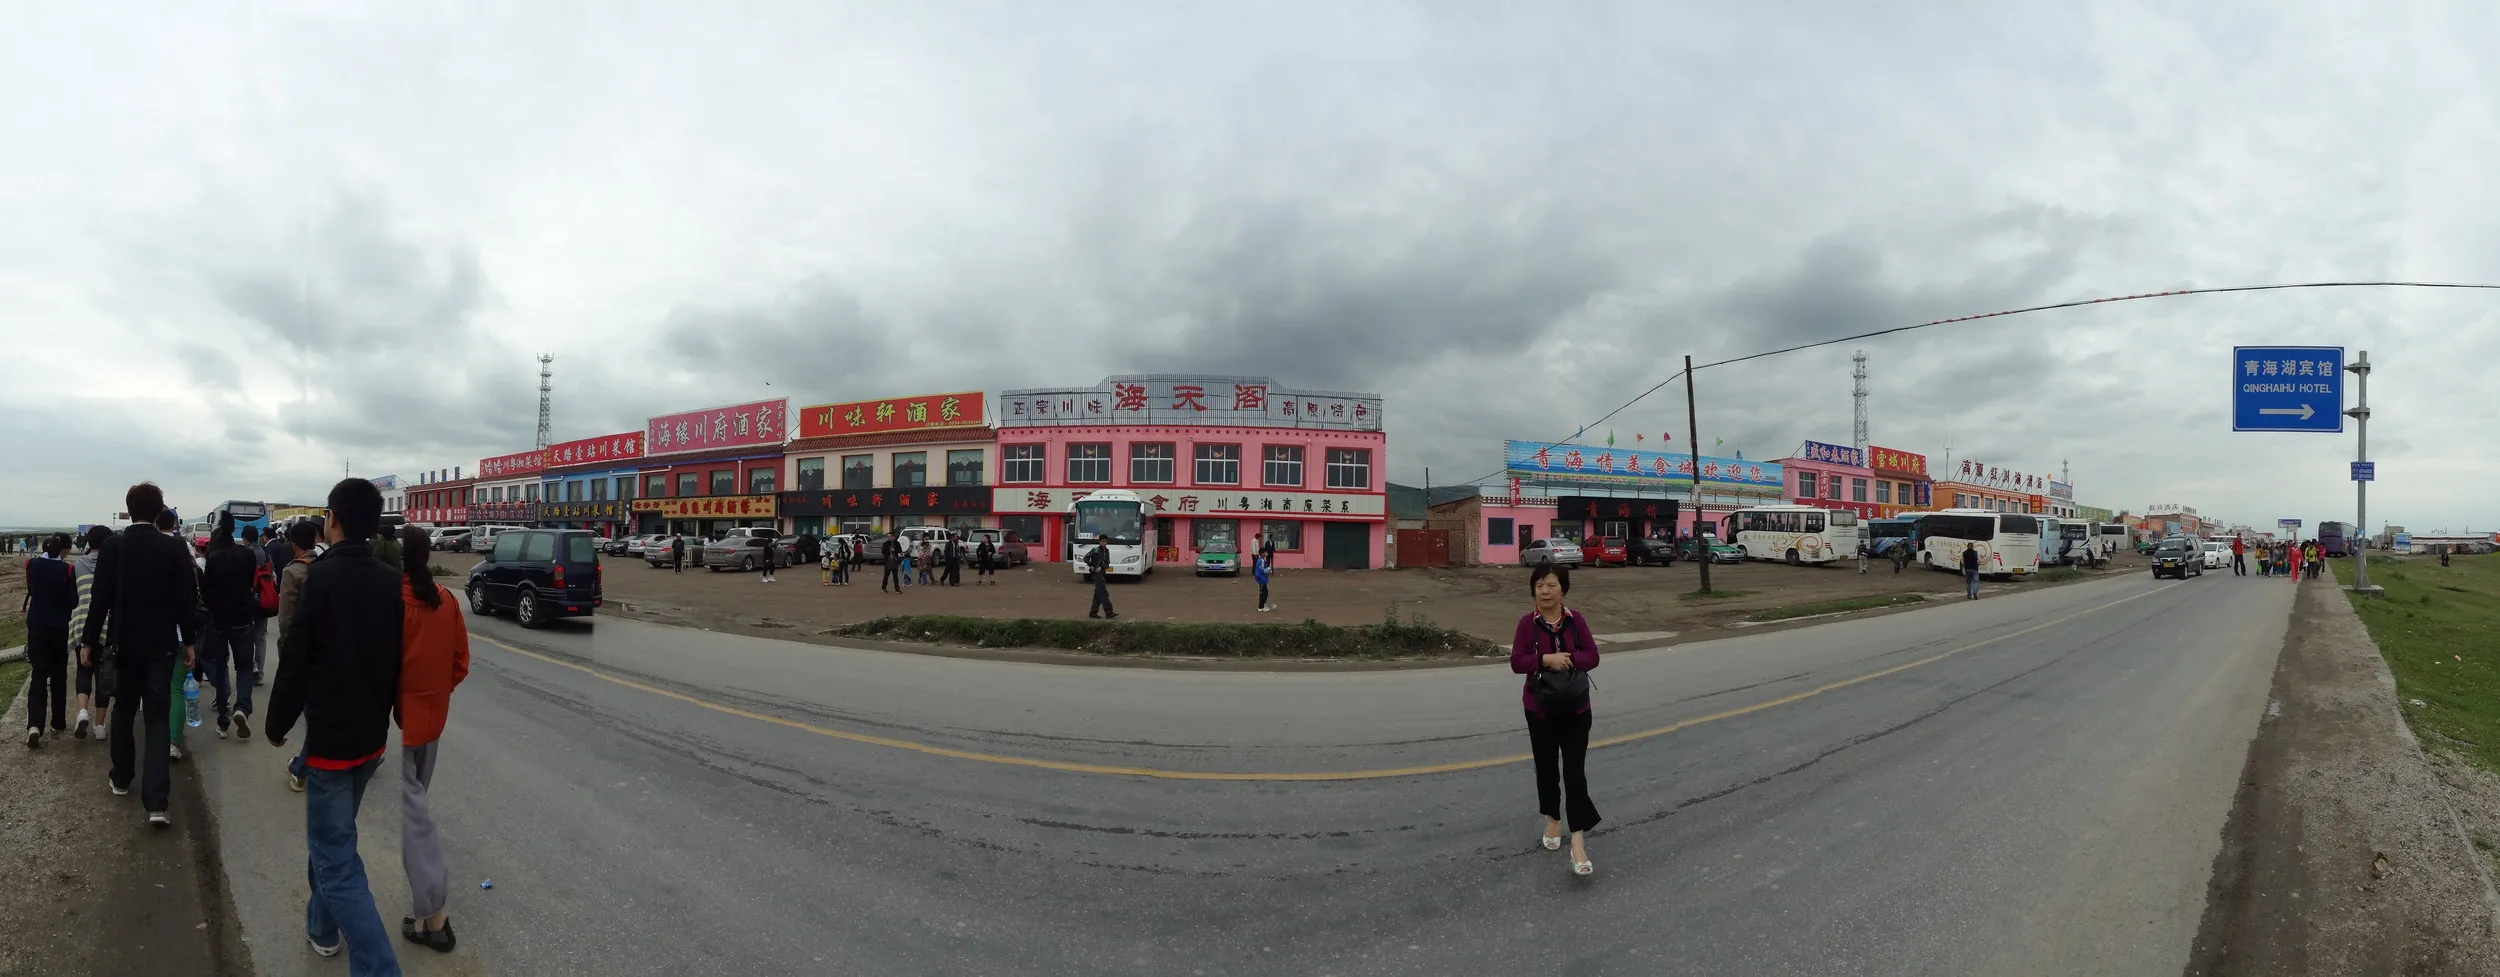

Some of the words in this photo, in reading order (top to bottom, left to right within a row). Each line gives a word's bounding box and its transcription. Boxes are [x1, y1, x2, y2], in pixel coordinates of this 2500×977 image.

[2244, 360, 2333, 376] 青海湖宾馆
[1115, 383, 1267, 411] 海天阁
[2243, 384, 2295, 393] QINGHAIHU
[2299, 384, 2332, 394] HOTEL
[818, 396, 961, 430] 川味轩酒家
[1013, 399, 1102, 415] 正宗川味
[1283, 401, 1367, 420] 高原特色
[658, 405, 773, 447] 海缘川府酒家
[553, 438, 636, 463] 天路壹站川菜馆
[1876, 450, 1920, 472] 雪域川府
[484, 454, 543, 475] 哈哈川粤湘菜馆
[1535, 447, 1763, 482] 青海情美食城欢迎您
